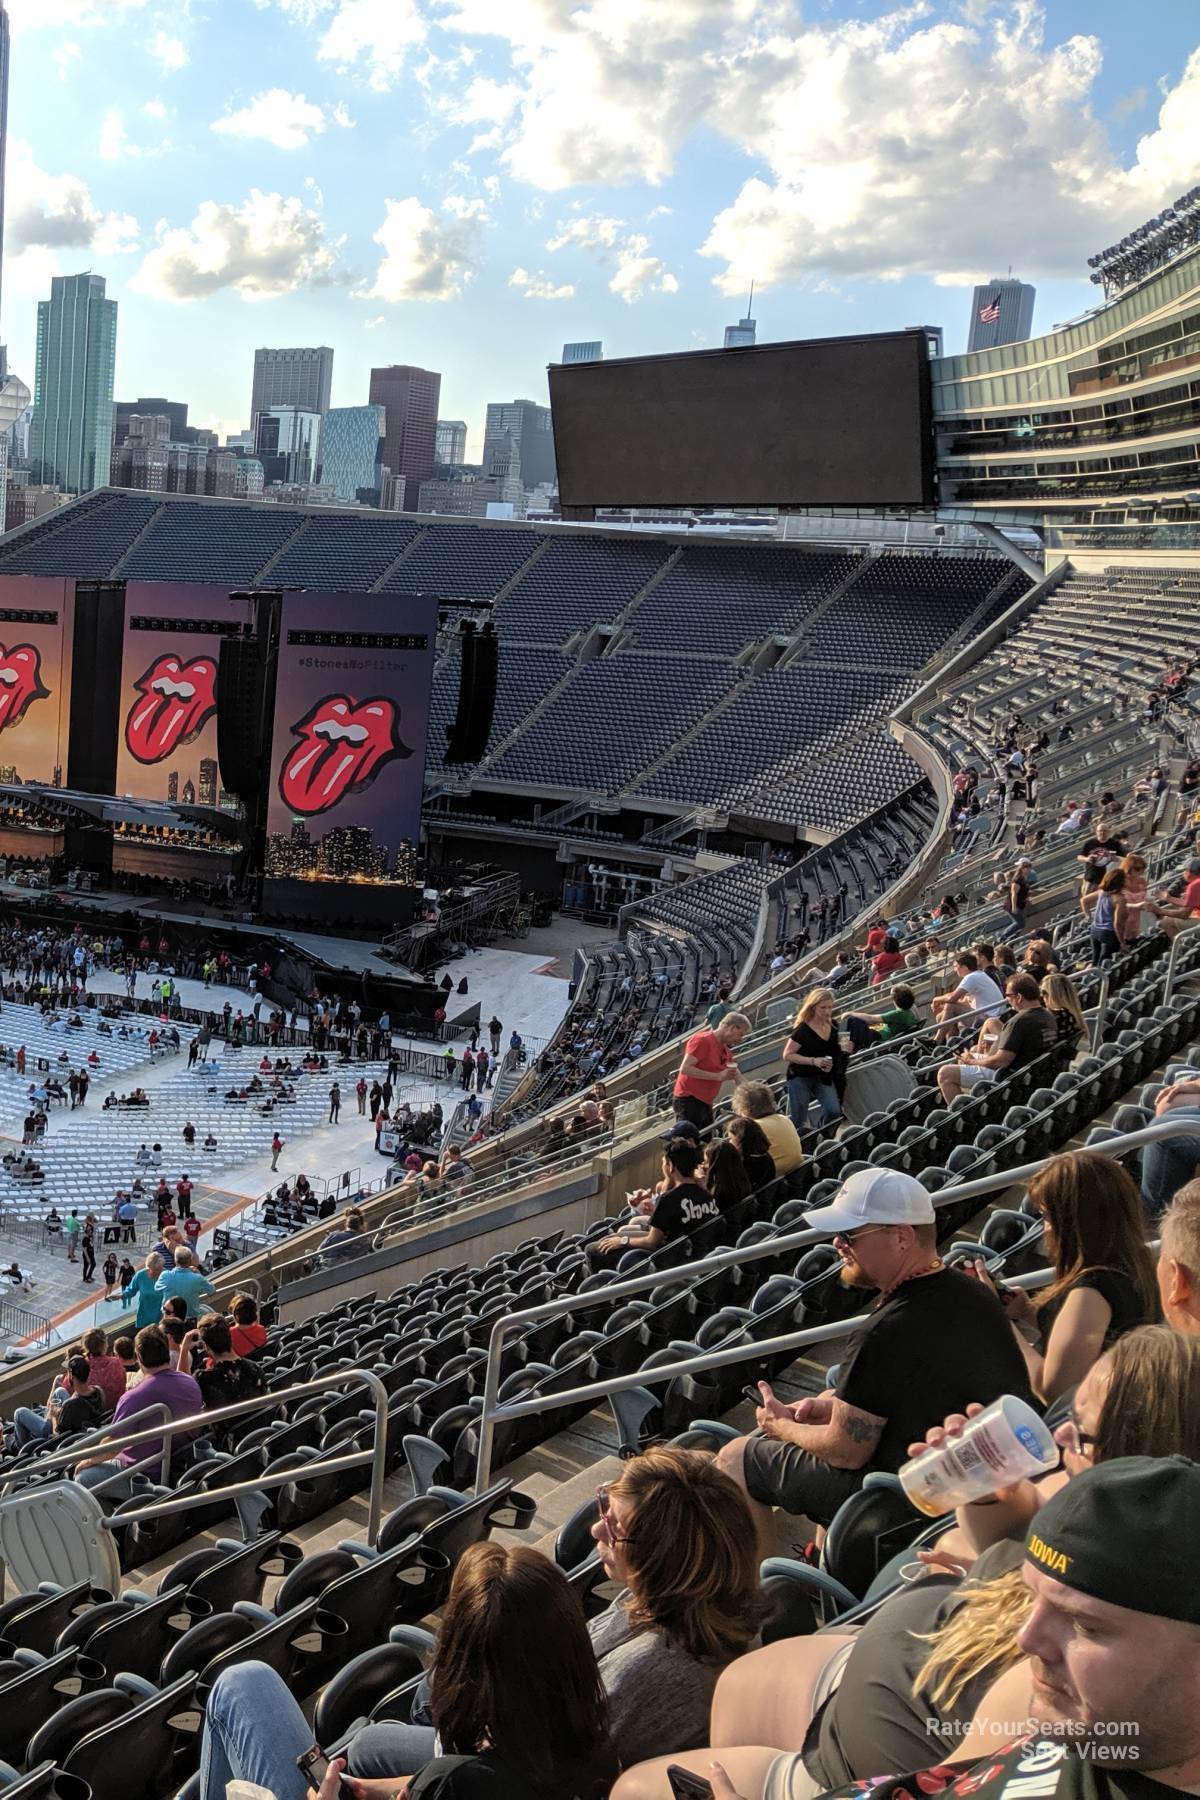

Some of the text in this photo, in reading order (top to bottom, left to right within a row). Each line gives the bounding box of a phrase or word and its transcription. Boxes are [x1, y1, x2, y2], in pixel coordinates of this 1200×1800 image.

[298, 657, 409, 672] #StonesNoFilter
[680, 1198, 720, 1224] Stones
[107, 1230, 116, 1241] A
